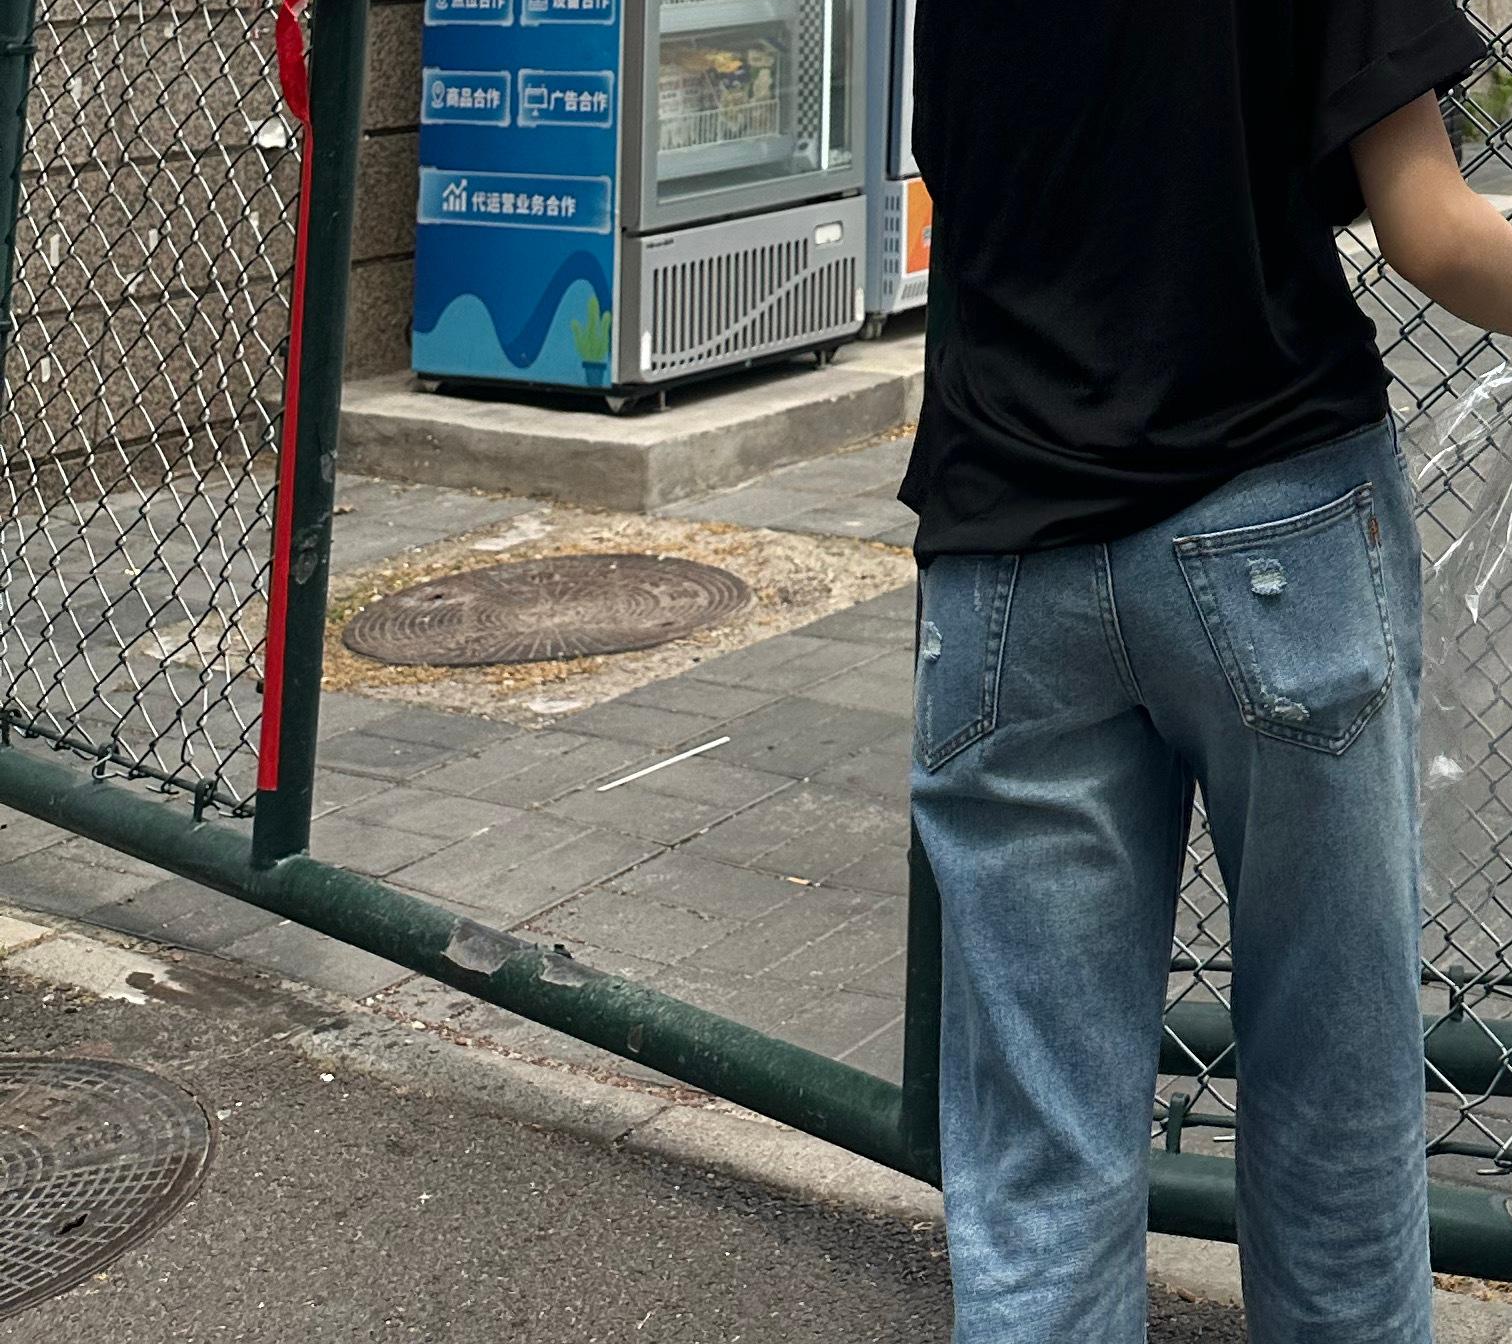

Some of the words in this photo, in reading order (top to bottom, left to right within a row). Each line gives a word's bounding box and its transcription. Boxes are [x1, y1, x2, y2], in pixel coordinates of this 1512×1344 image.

[446, 87, 501, 109] 商品合作
[550, 90, 609, 113] 广告合作
[471, 190, 577, 217] 代运营业务合作
